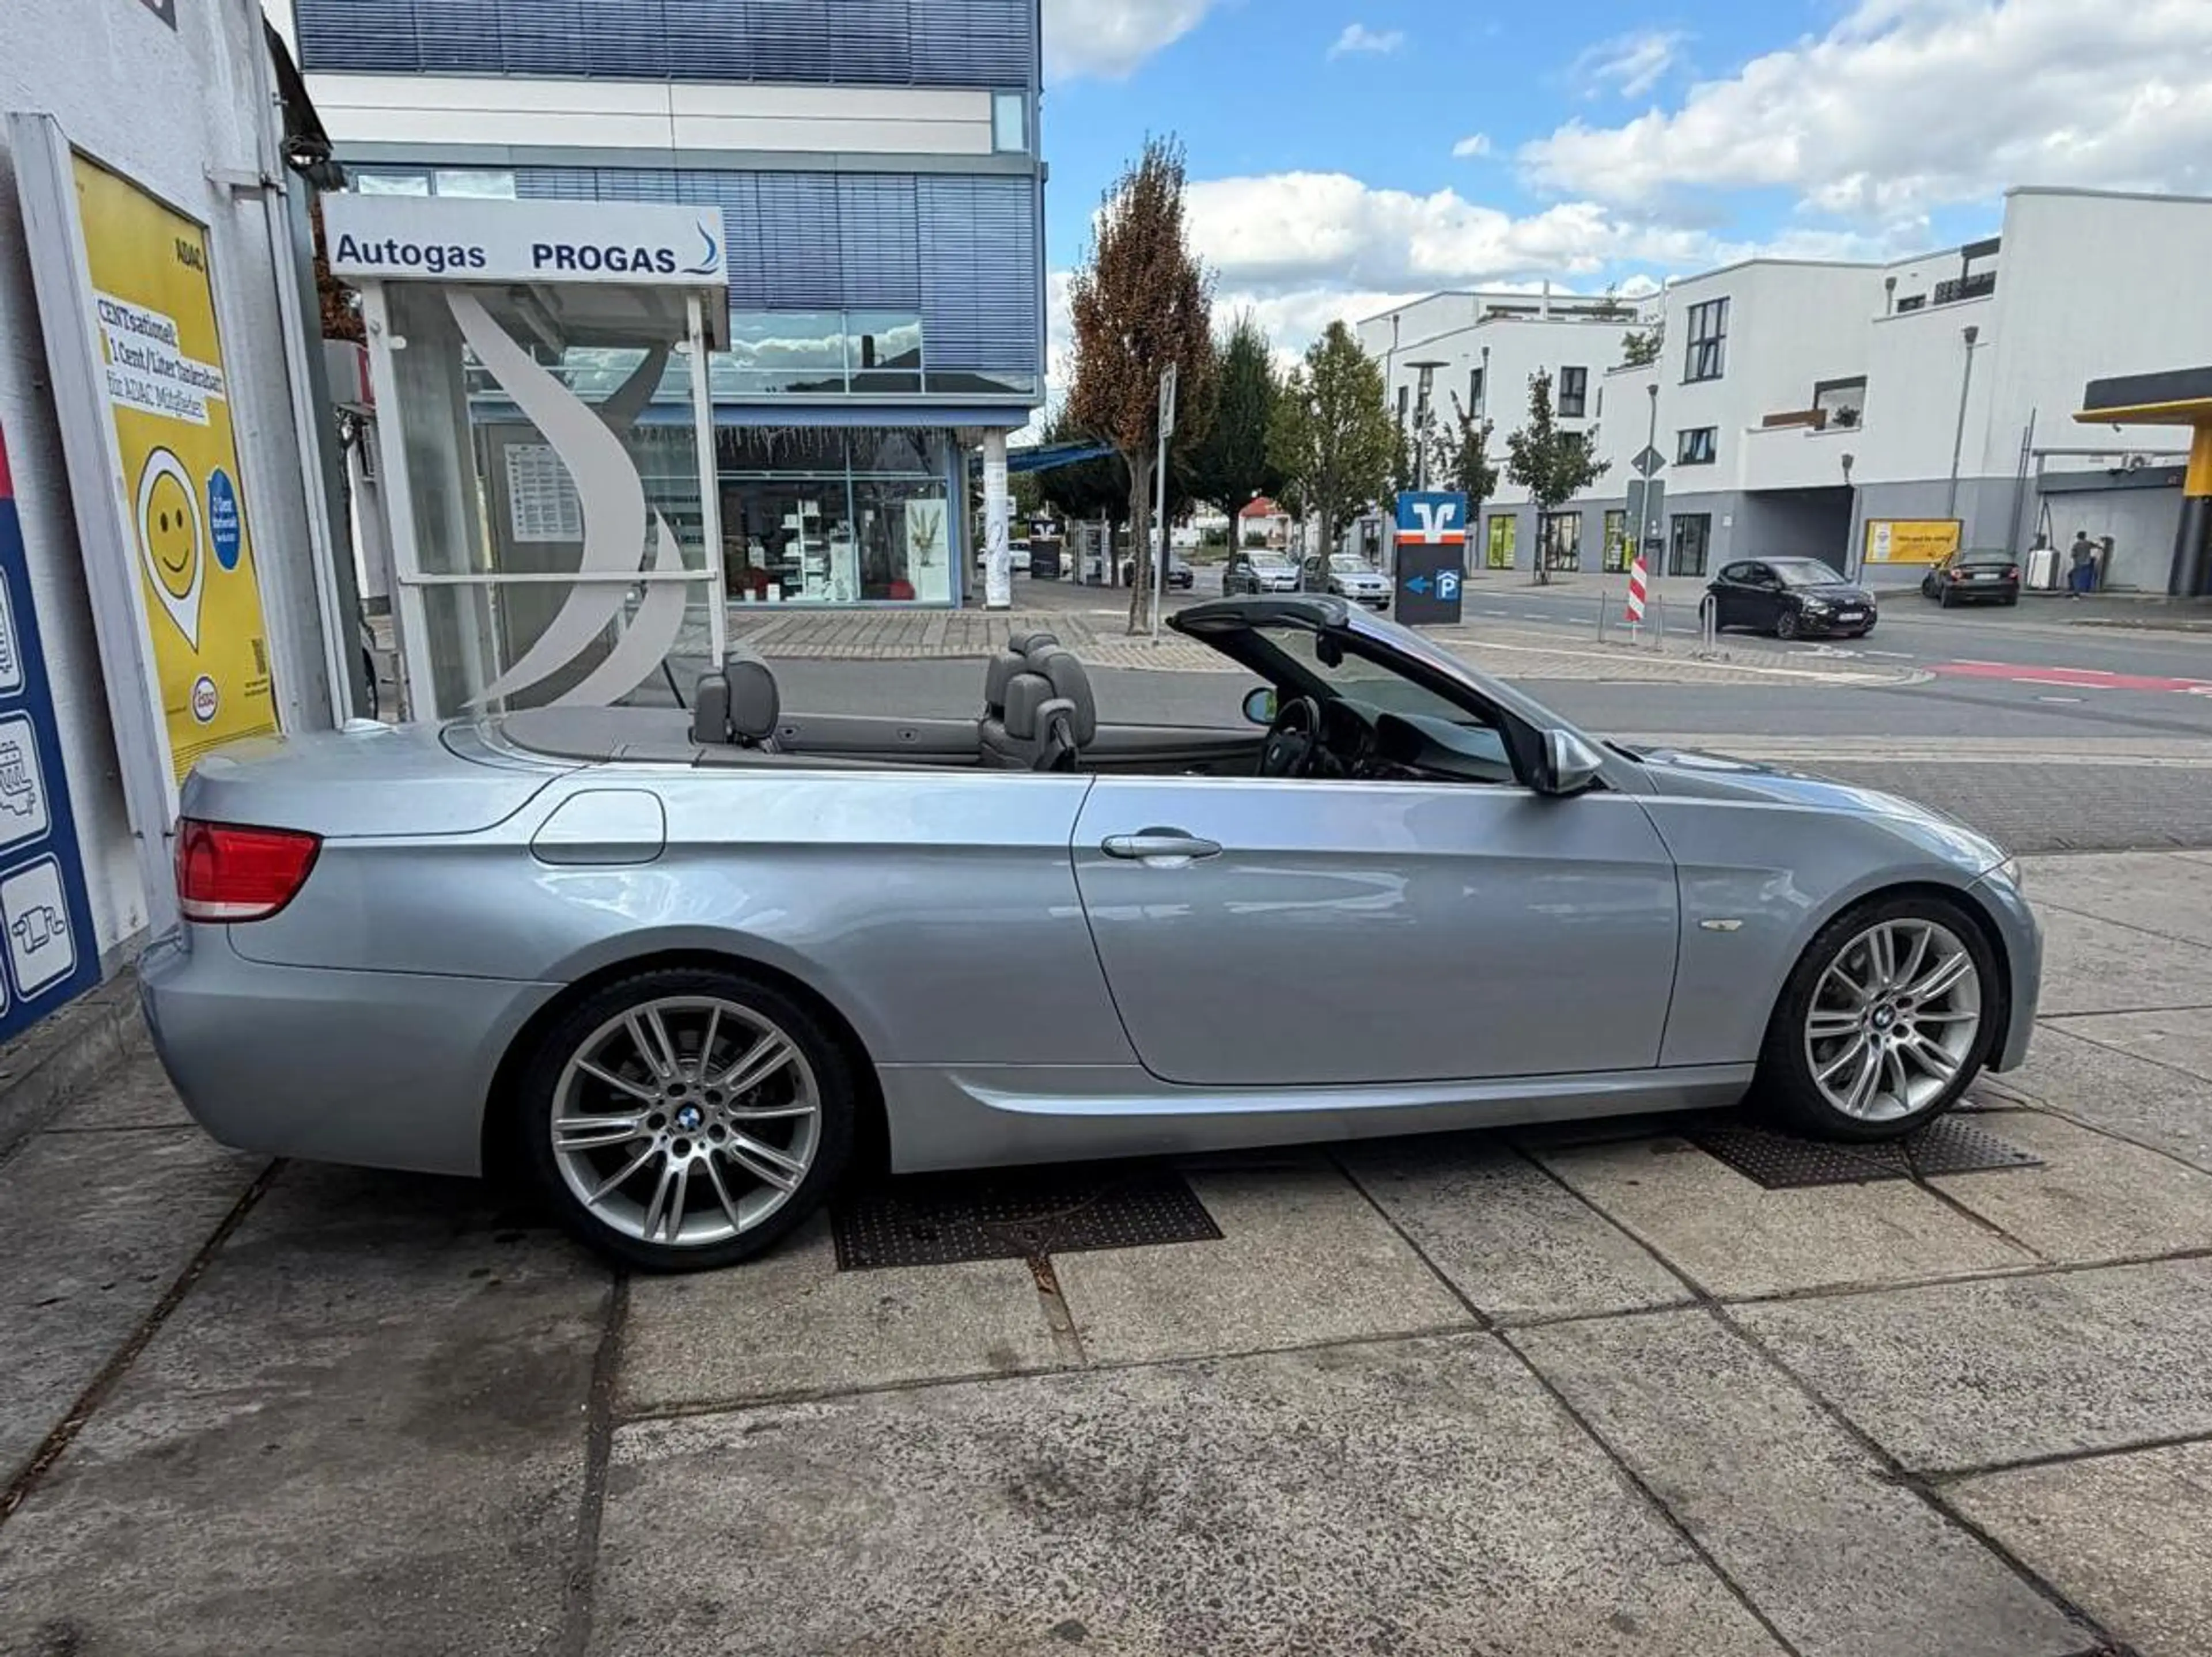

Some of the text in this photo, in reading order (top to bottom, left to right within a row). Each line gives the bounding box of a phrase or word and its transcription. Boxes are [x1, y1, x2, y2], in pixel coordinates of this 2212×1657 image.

[336, 233, 676, 274] Autogas PROGAS
[1441, 579, 1455, 598] P
